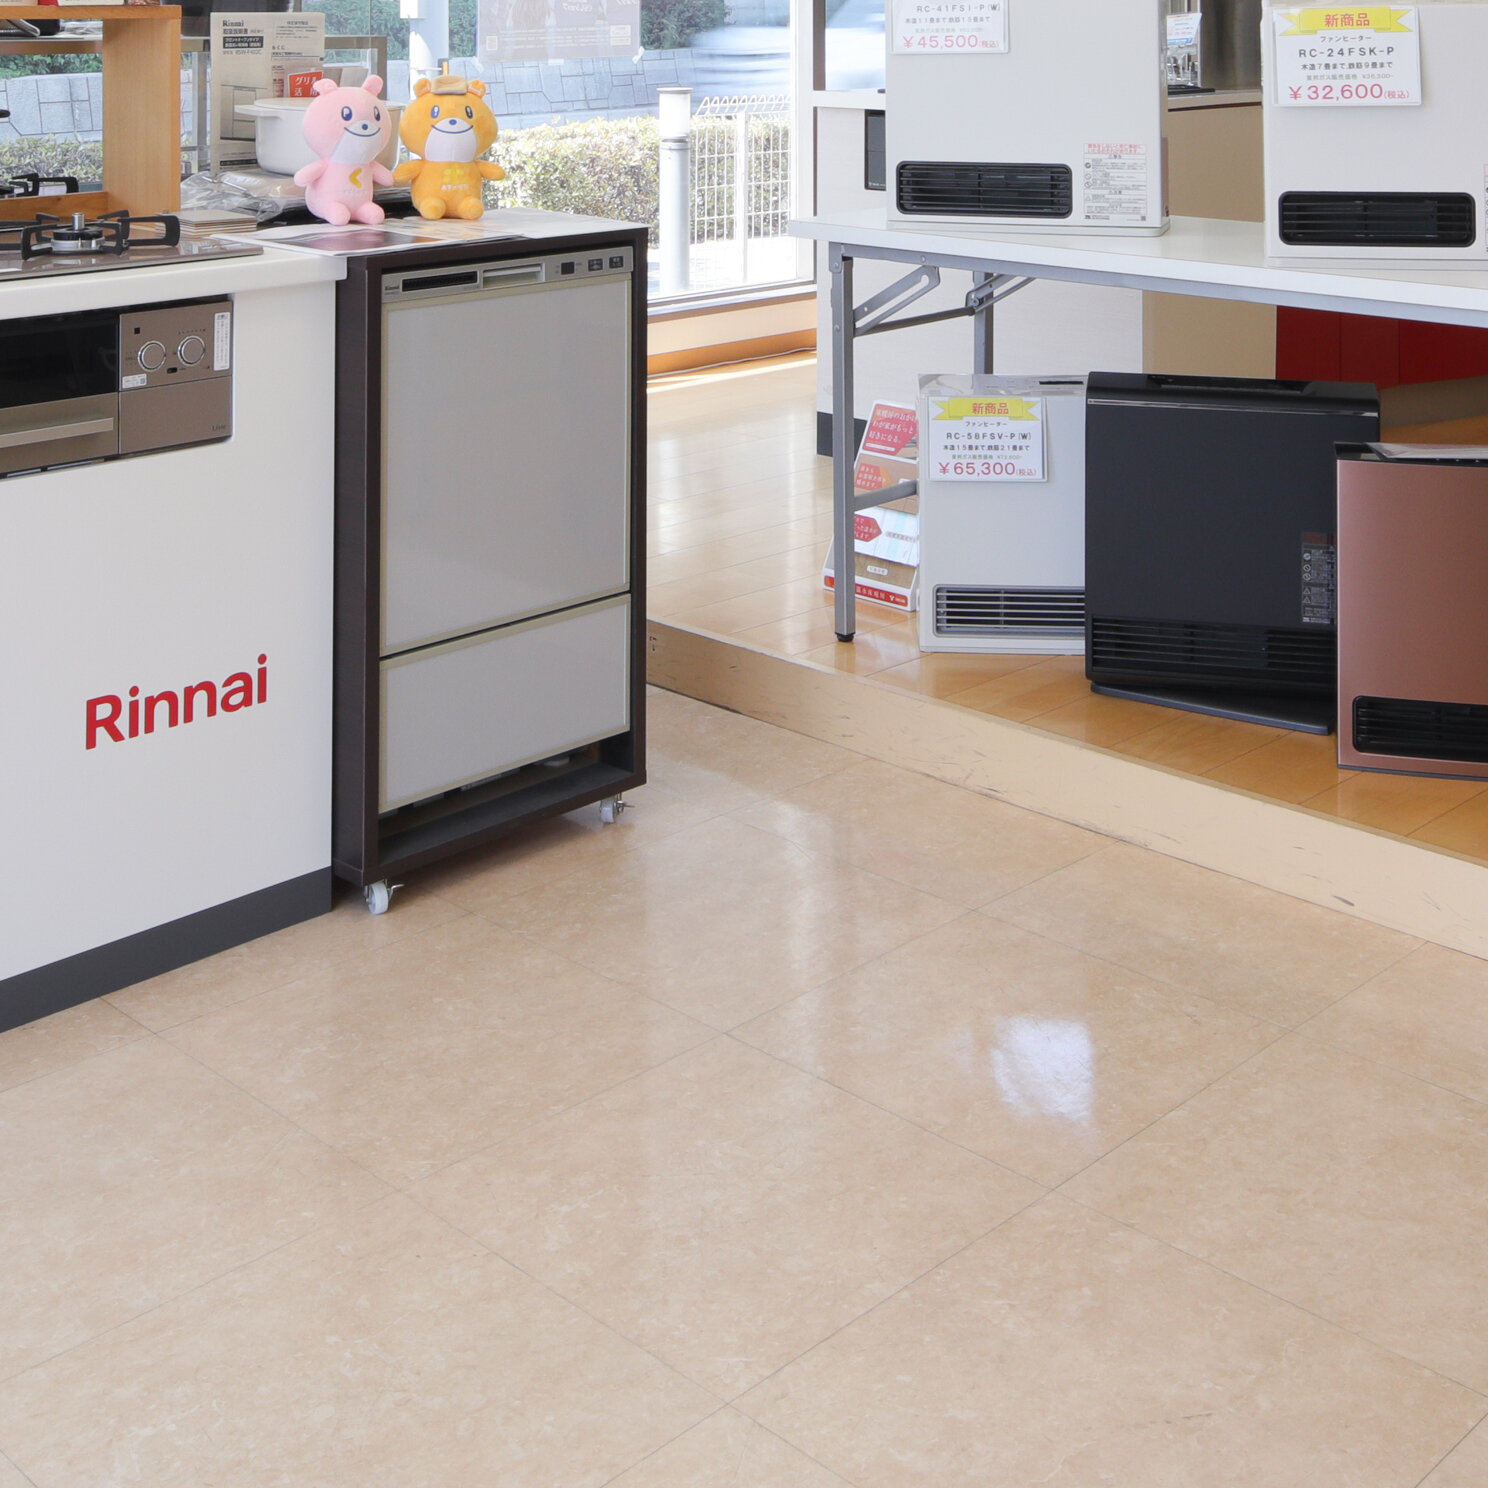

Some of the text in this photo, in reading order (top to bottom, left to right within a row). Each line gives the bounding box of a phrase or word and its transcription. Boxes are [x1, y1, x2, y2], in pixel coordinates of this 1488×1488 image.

[1324, 12, 1370, 28] 新商品
[1320, 35, 1372, 43] ファンヒーター
[1298, 46, 1395, 58] RC-24FSK-P
[971, 402, 1009, 415] 新商品
[84, 653, 269, 750] Rinnai
